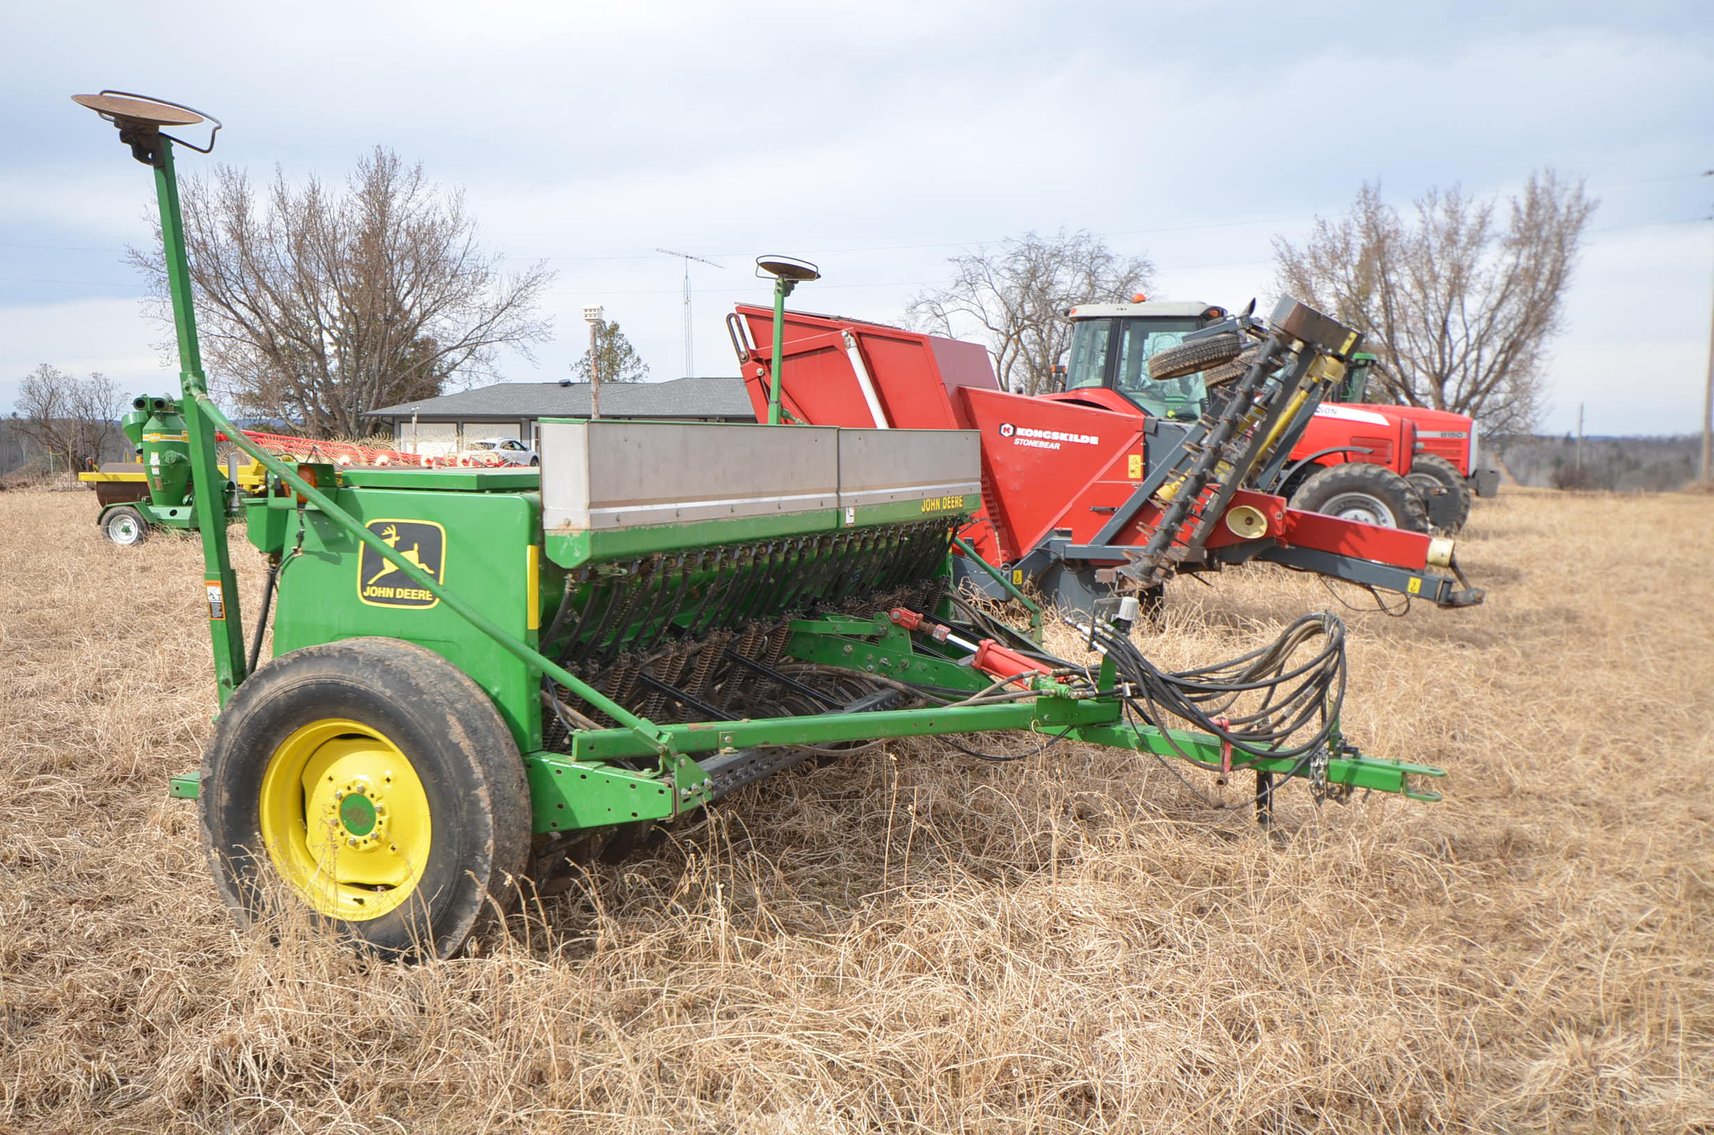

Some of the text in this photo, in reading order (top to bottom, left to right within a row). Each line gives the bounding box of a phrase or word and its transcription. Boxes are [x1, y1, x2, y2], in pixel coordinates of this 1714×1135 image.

[1016, 427, 1099, 445] KONGSKILDE
[1013, 438, 1061, 450] STONEBEAR
[921, 496, 963, 512] JOHN DEERE
[363, 586, 433, 600] JOHN DEERE
